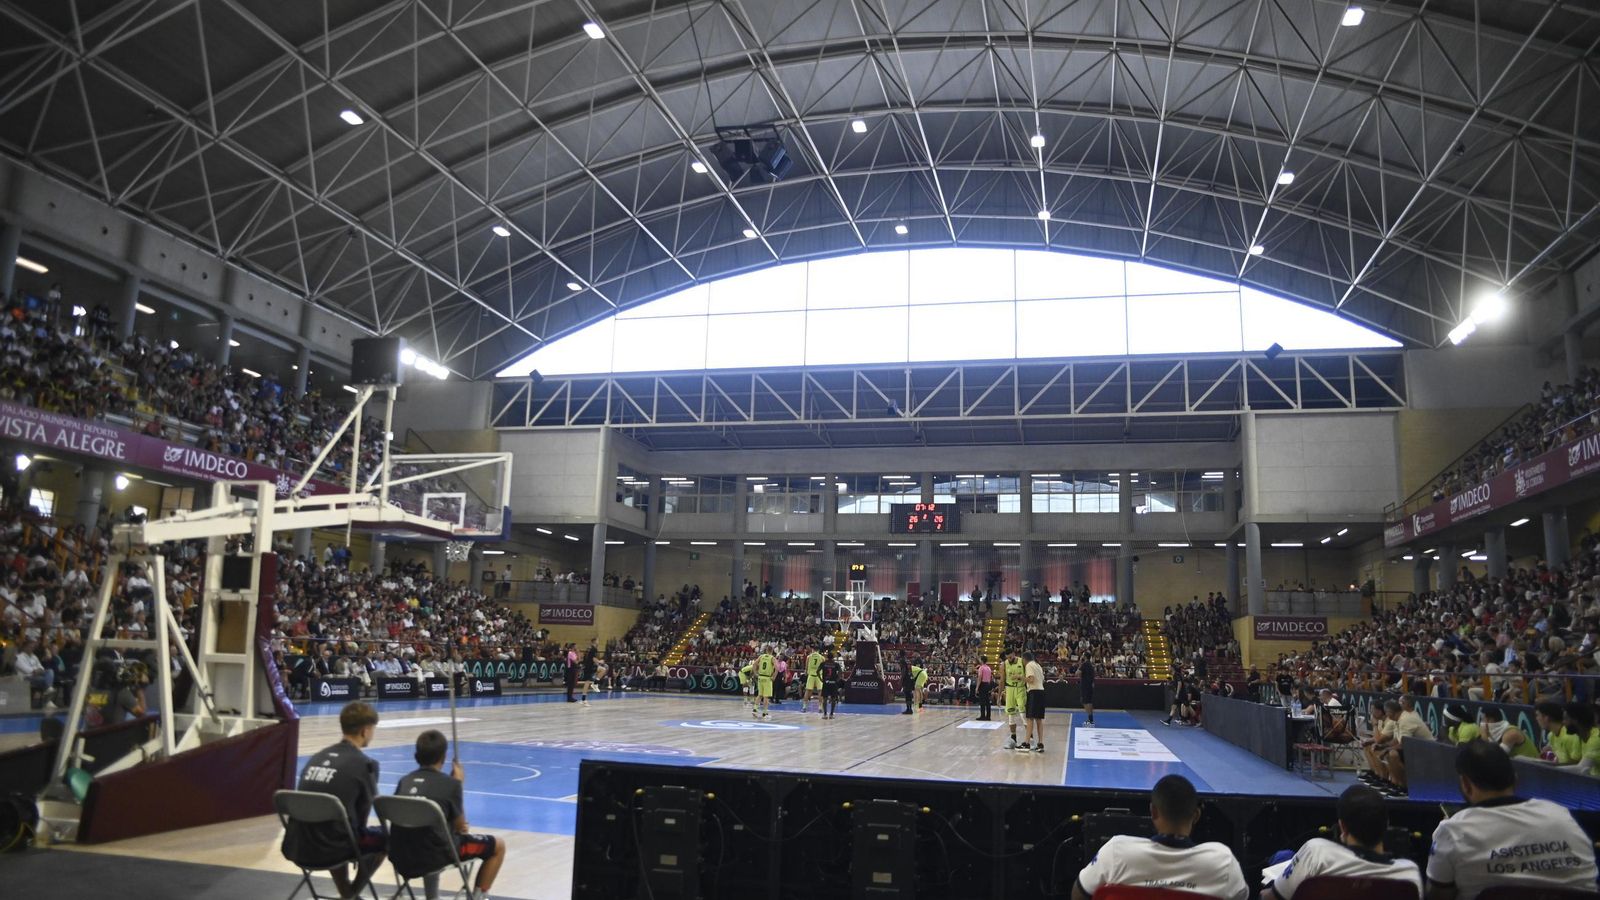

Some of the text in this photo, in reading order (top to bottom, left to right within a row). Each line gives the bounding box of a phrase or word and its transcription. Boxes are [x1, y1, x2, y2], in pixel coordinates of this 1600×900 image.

[1, 404, 119, 439] PALACIO MUNICIPAL DEPORTES
[54, 428, 126, 459] ALEGRE
[185, 449, 248, 479] IMDECO
[1459, 483, 1491, 510] IMDECO
[909, 515, 918, 523] 26
[934, 515, 943, 523] 26
[552, 608, 592, 618] IMDECO
[1272, 621, 1325, 632] IMDECO
[305, 766, 337, 783] STAFF
[1490, 840, 1570, 860] ASISTENCIA
[1486, 856, 1581, 874] LOS ANGELES
